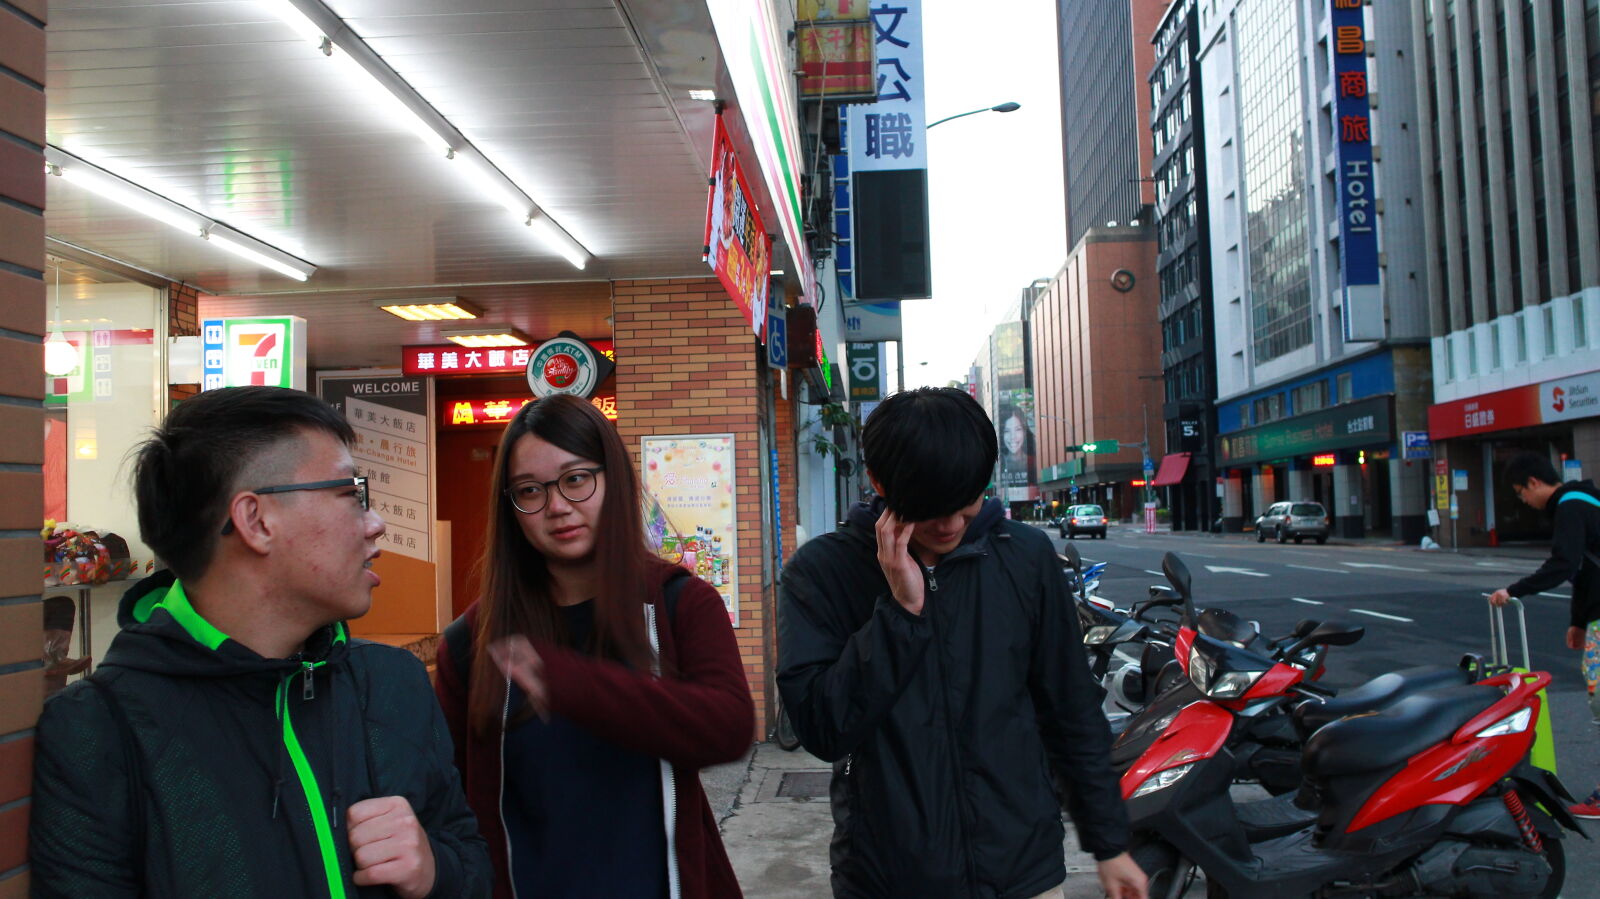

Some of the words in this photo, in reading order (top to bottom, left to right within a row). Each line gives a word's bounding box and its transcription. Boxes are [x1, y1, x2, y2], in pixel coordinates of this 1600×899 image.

[1346, 161, 1372, 232] Hotel
[417, 349, 529, 369] 華美大飯店
[352, 381, 420, 394] WELCOME
[354, 408, 416, 433] 華美大飯店
